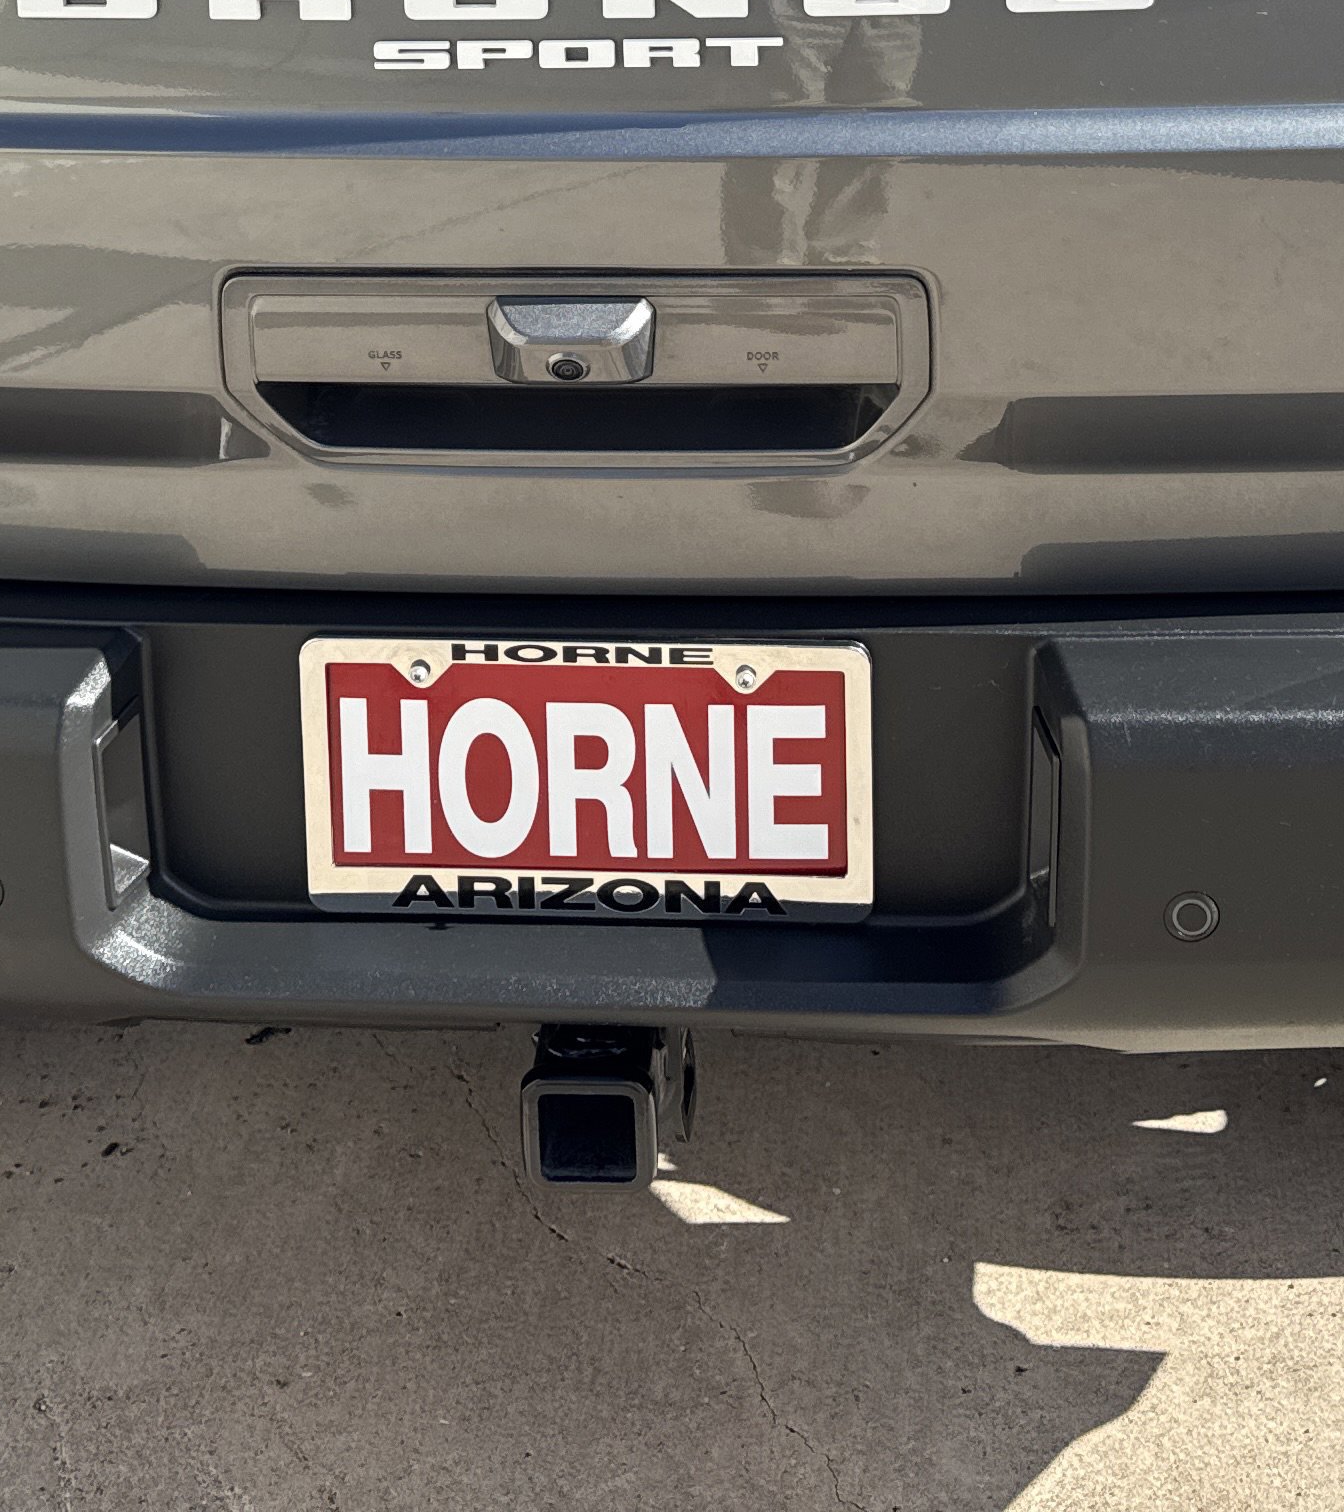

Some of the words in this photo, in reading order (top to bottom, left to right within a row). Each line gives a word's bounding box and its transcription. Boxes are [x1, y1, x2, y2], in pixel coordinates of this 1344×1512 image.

[373, 37, 784, 70] SPORT
[367, 350, 402, 359] GLASS
[746, 351, 779, 361] DOOR
[451, 643, 715, 666] HORNE
[338, 696, 830, 860] HORNE
[391, 874, 788, 916] ARIZONA
